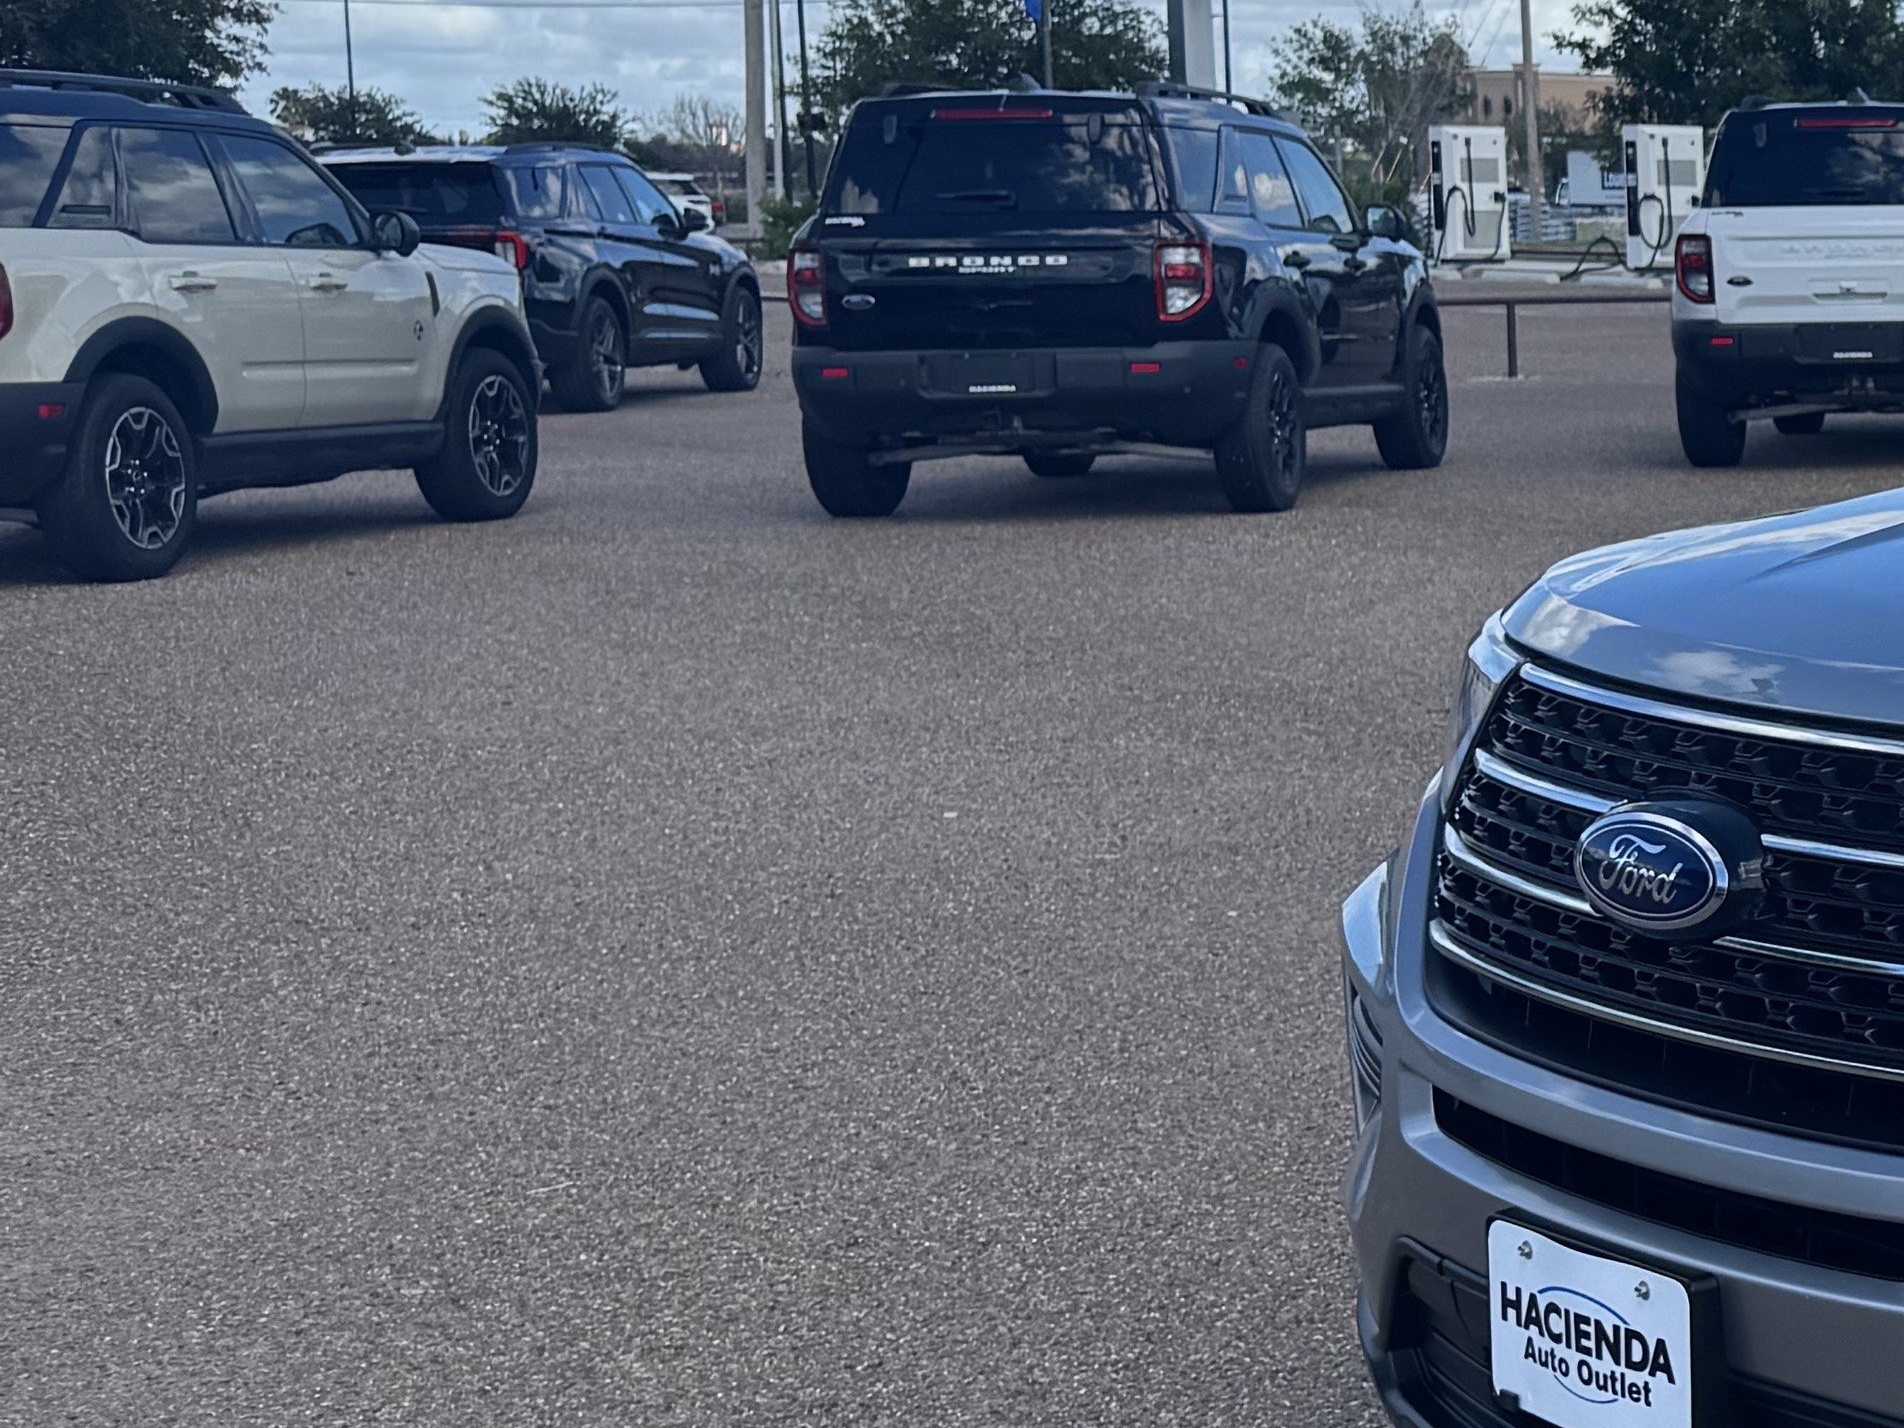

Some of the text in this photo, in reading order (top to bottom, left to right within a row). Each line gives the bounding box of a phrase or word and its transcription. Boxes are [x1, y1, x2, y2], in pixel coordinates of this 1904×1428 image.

[1598, 833, 1684, 905] Ford
[1500, 1280, 1676, 1385] HACIENDA
[1524, 1335, 1652, 1408] Auto Outlet
